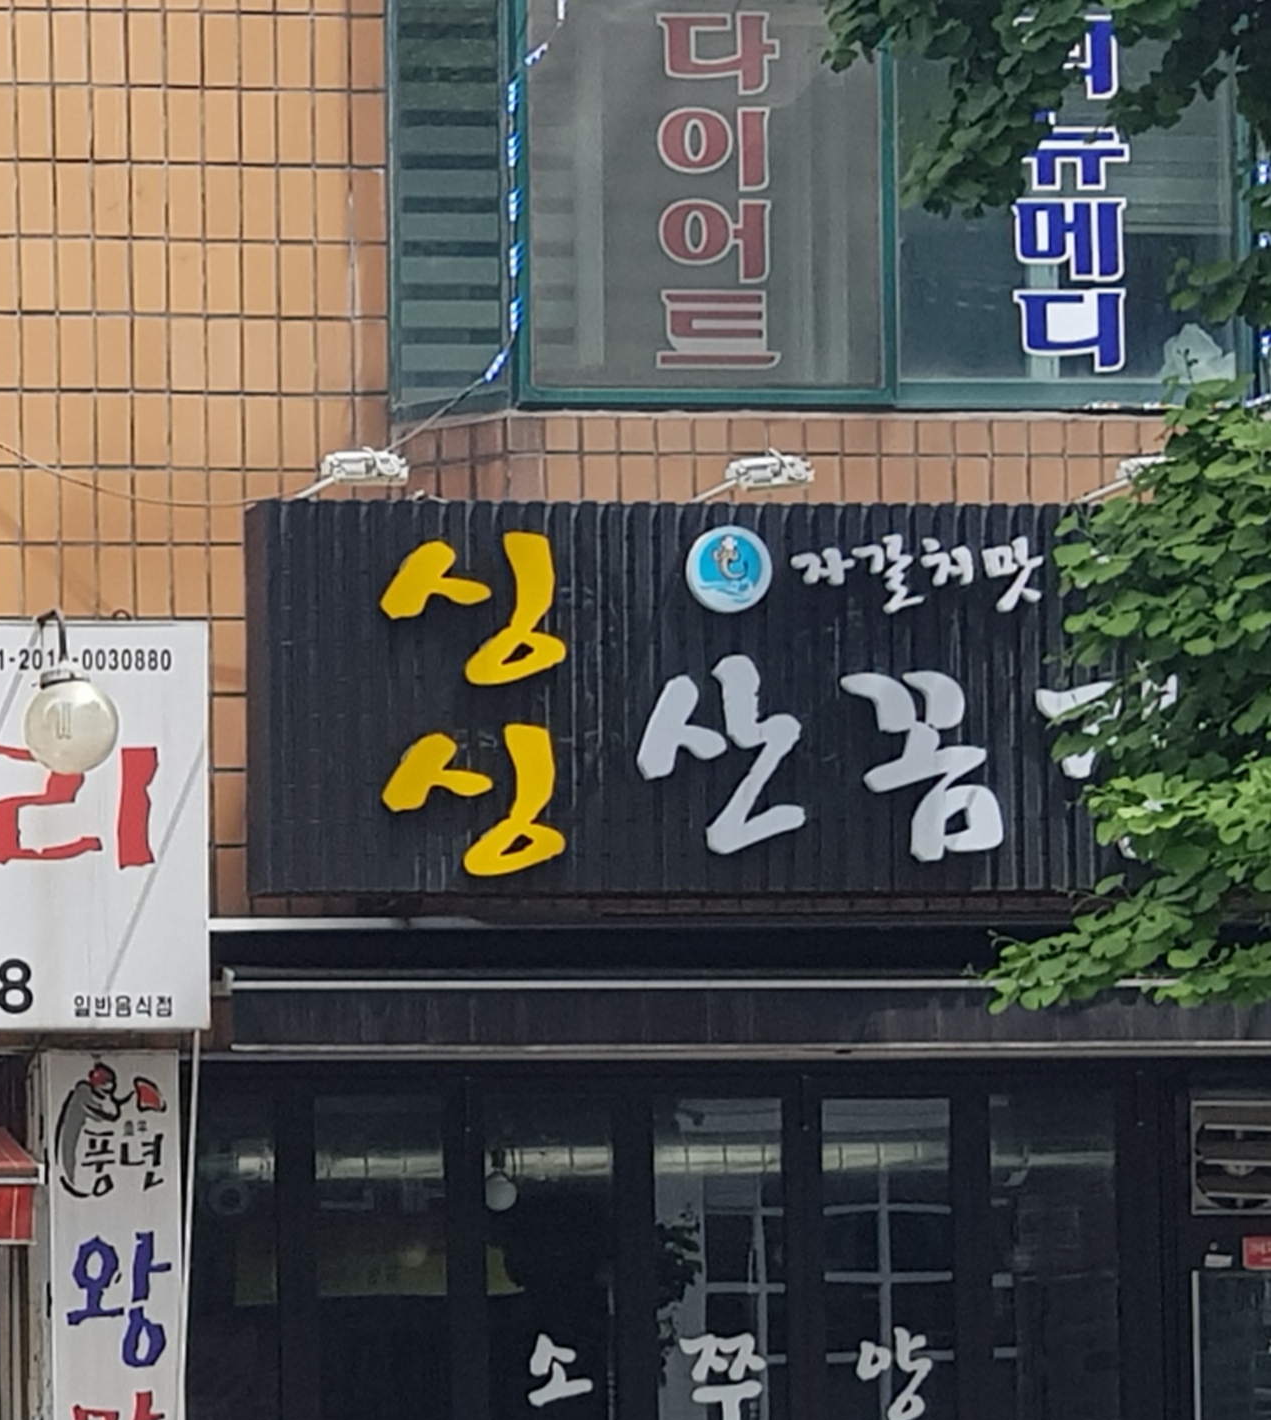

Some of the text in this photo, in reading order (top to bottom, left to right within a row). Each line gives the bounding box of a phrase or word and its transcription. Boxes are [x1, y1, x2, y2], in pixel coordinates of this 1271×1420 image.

[656, 11, 781, 370] 다이어트
[791, 533, 1043, 614] 자갈치맛
[380, 531, 567, 877] 싱싱
[74, 994, 173, 1018] 일반음식점
[81, 1127, 164, 1197] 풍년
[66, 1231, 171, 1368] 왕
